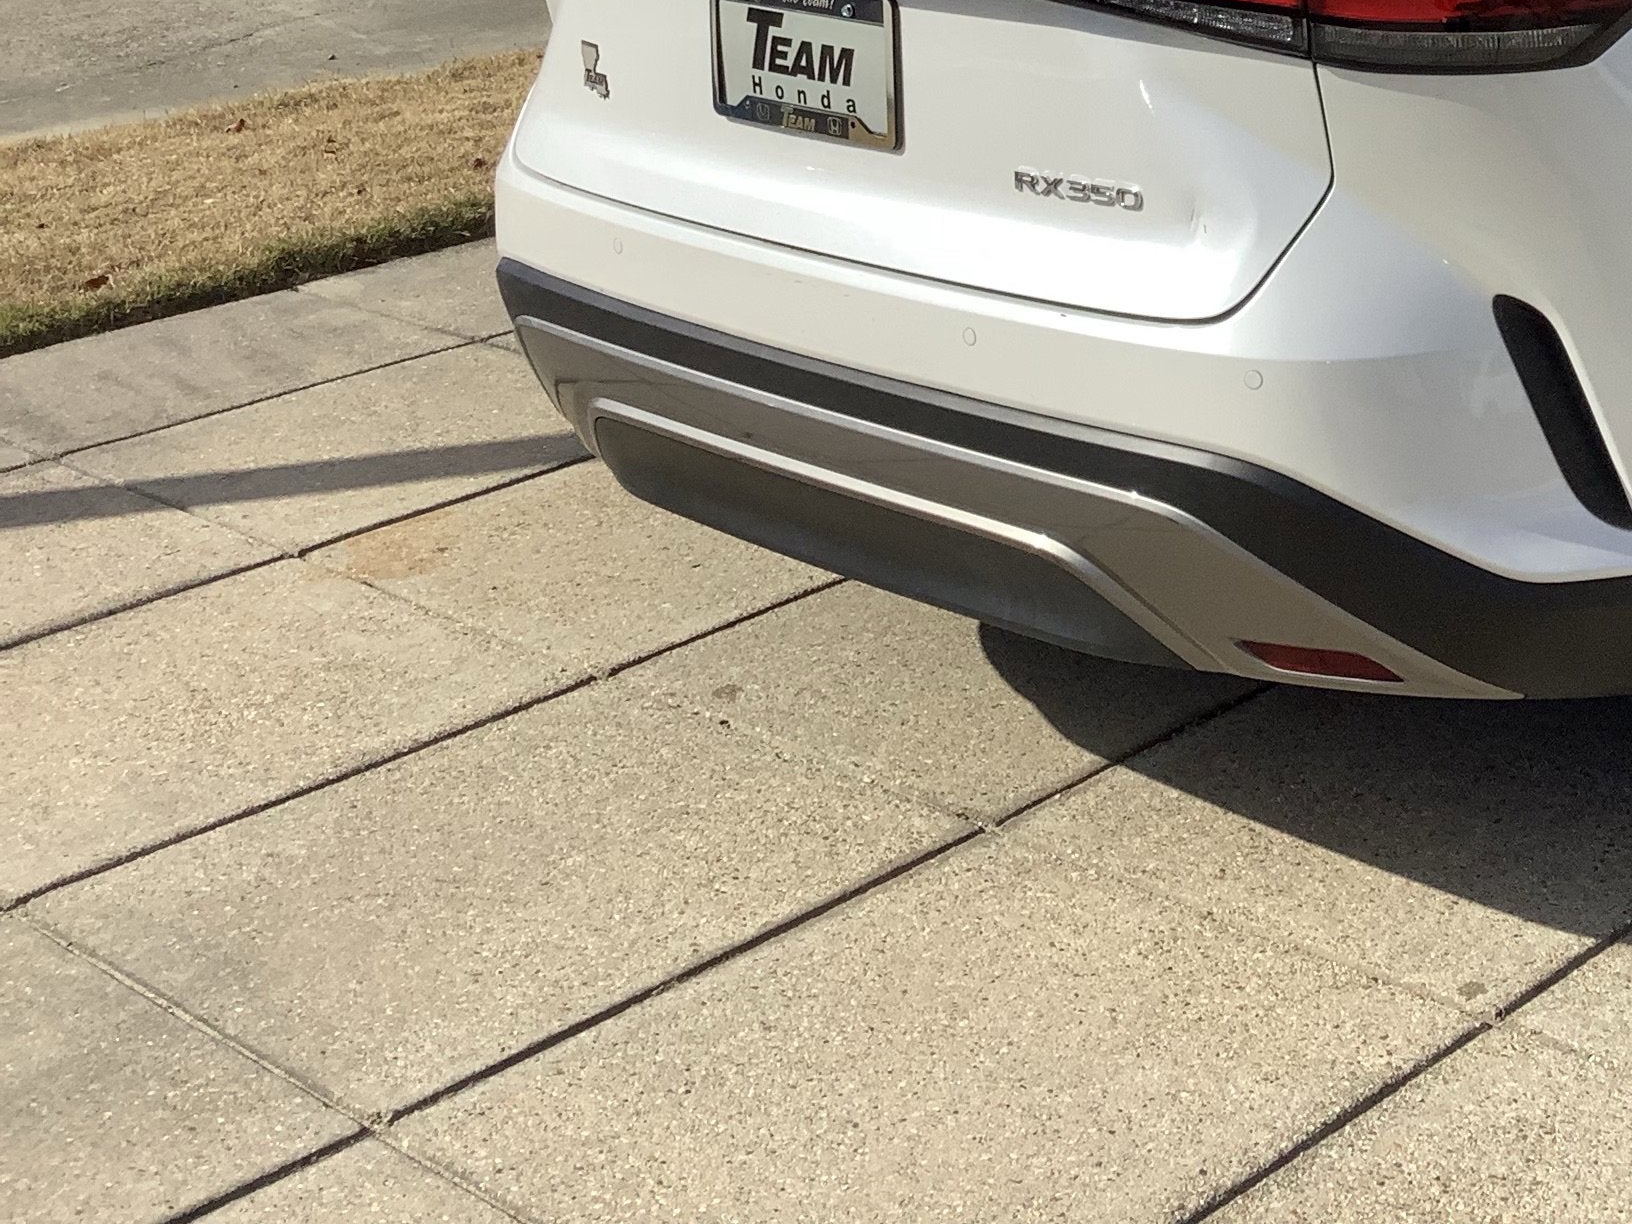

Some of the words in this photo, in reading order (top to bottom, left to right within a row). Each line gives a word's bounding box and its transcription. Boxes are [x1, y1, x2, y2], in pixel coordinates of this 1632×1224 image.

[746, 7, 855, 87] TEAM
[751, 75, 857, 114] Honda
[780, 105, 816, 132] TEAM
